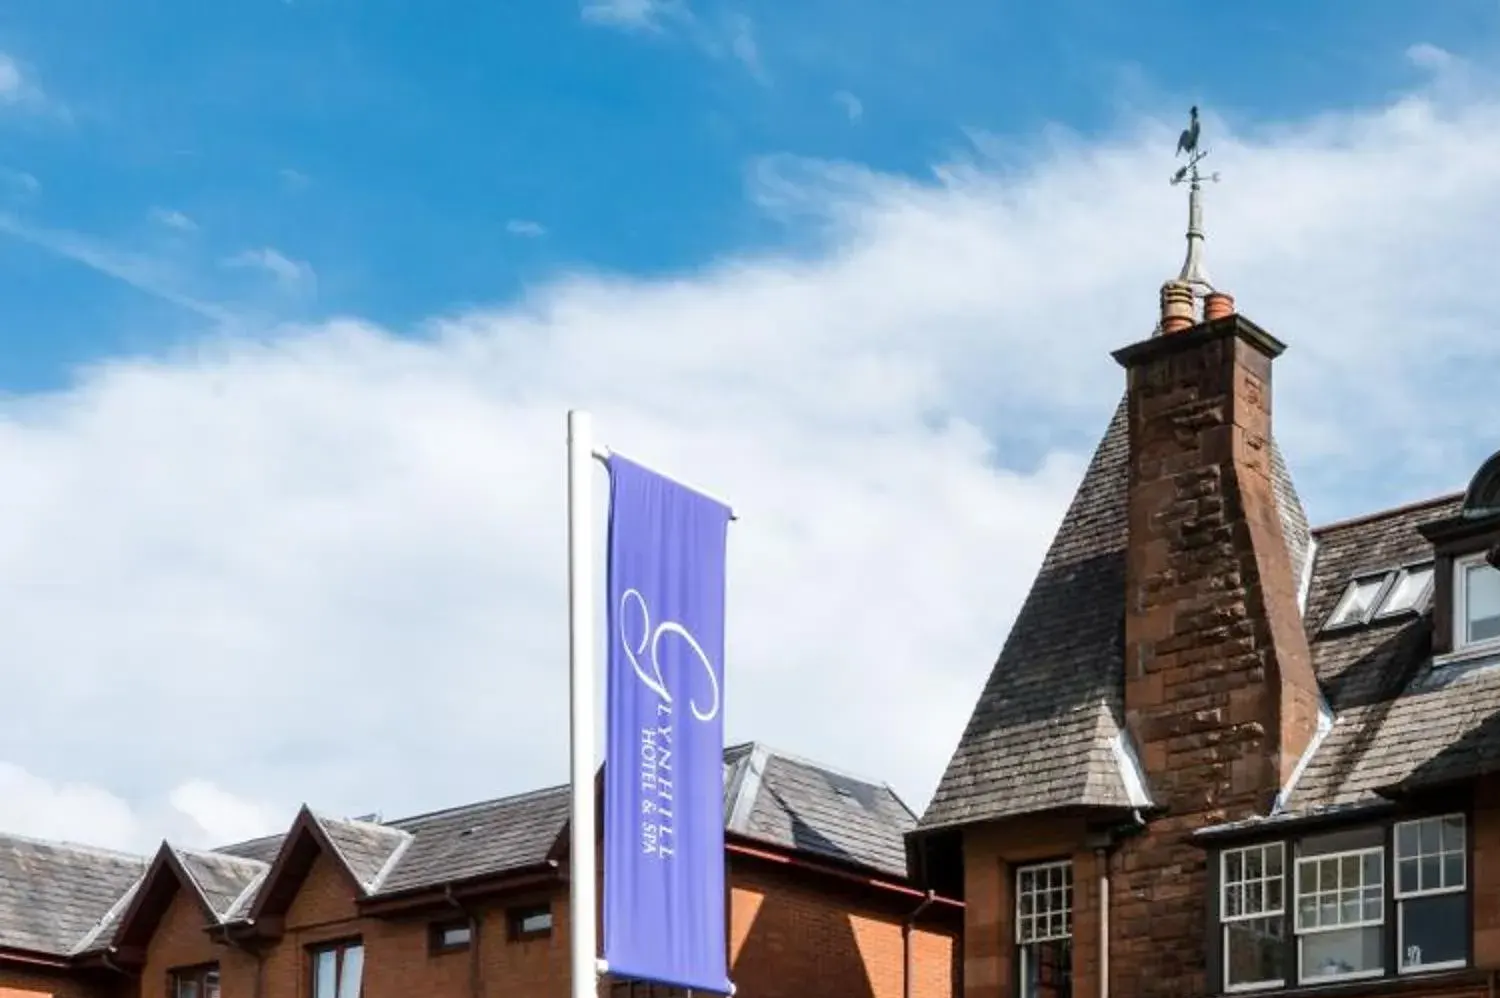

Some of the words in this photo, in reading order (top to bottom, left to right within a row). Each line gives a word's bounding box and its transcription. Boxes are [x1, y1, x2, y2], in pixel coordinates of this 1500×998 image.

[641, 728, 657, 791] HOTEL
[641, 799, 657, 814] &
[641, 821, 657, 854] SPA
